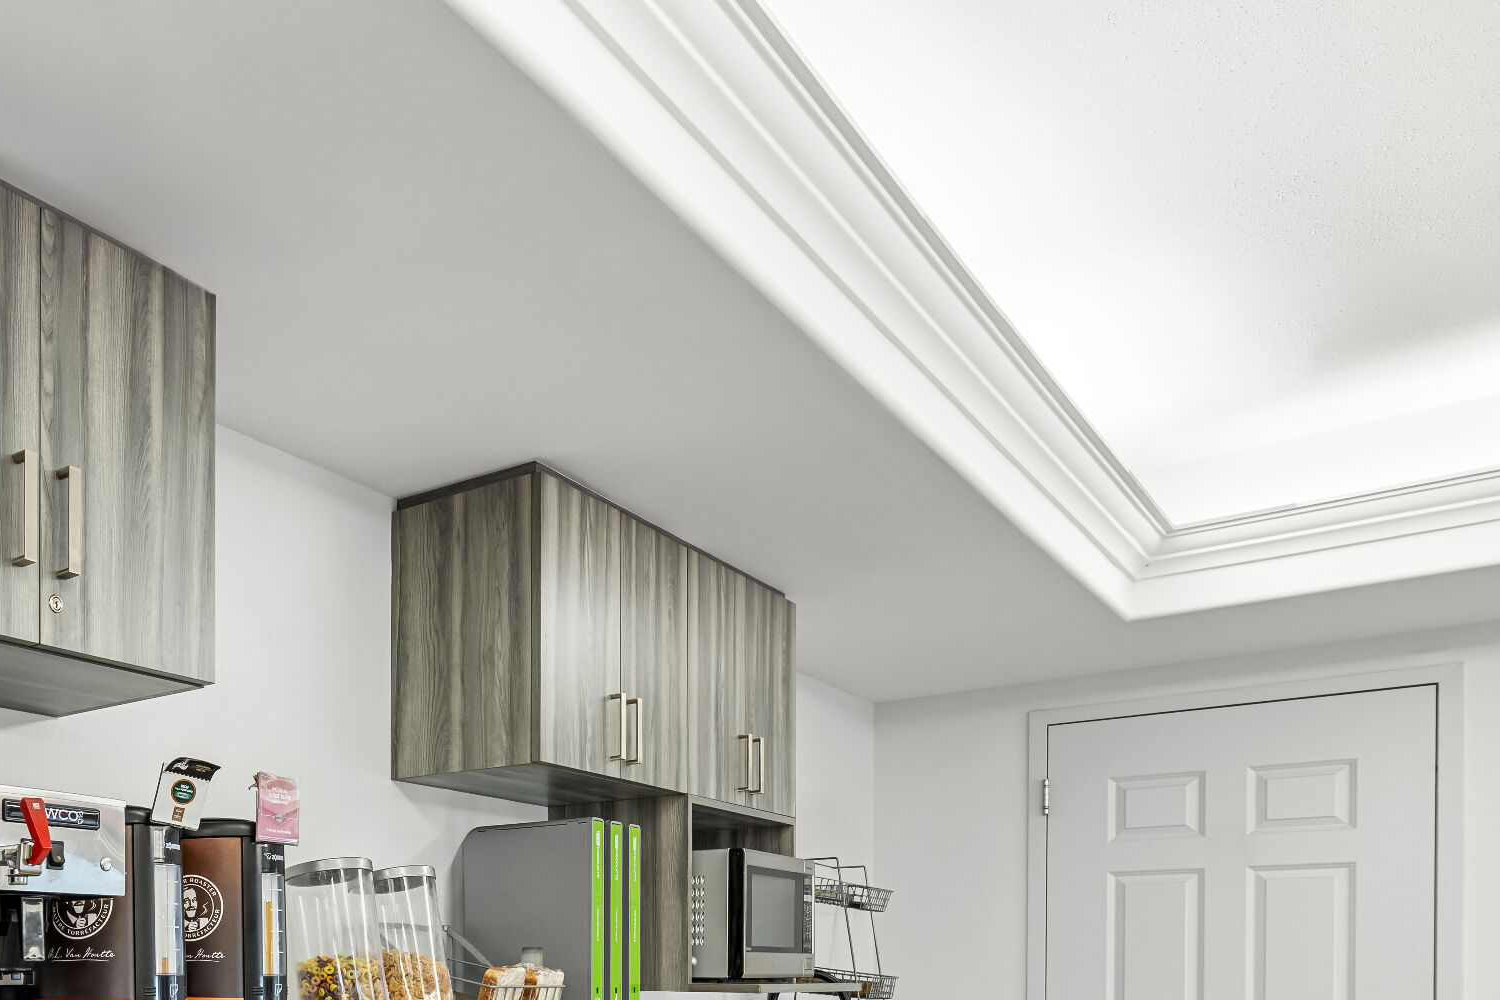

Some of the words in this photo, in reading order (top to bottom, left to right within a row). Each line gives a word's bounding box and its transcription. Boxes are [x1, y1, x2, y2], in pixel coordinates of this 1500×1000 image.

[45, 808, 79, 821] WCO
[189, 877, 217, 897] ROASTER
[67, 903, 110, 937] TORRÉFACTEUR
[184, 908, 221, 939] ORRÉFACTEUR
[65, 947, 81, 958] Van
[83, 946, 116, 959] Houtte
[195, 948, 226, 959] Houtte
